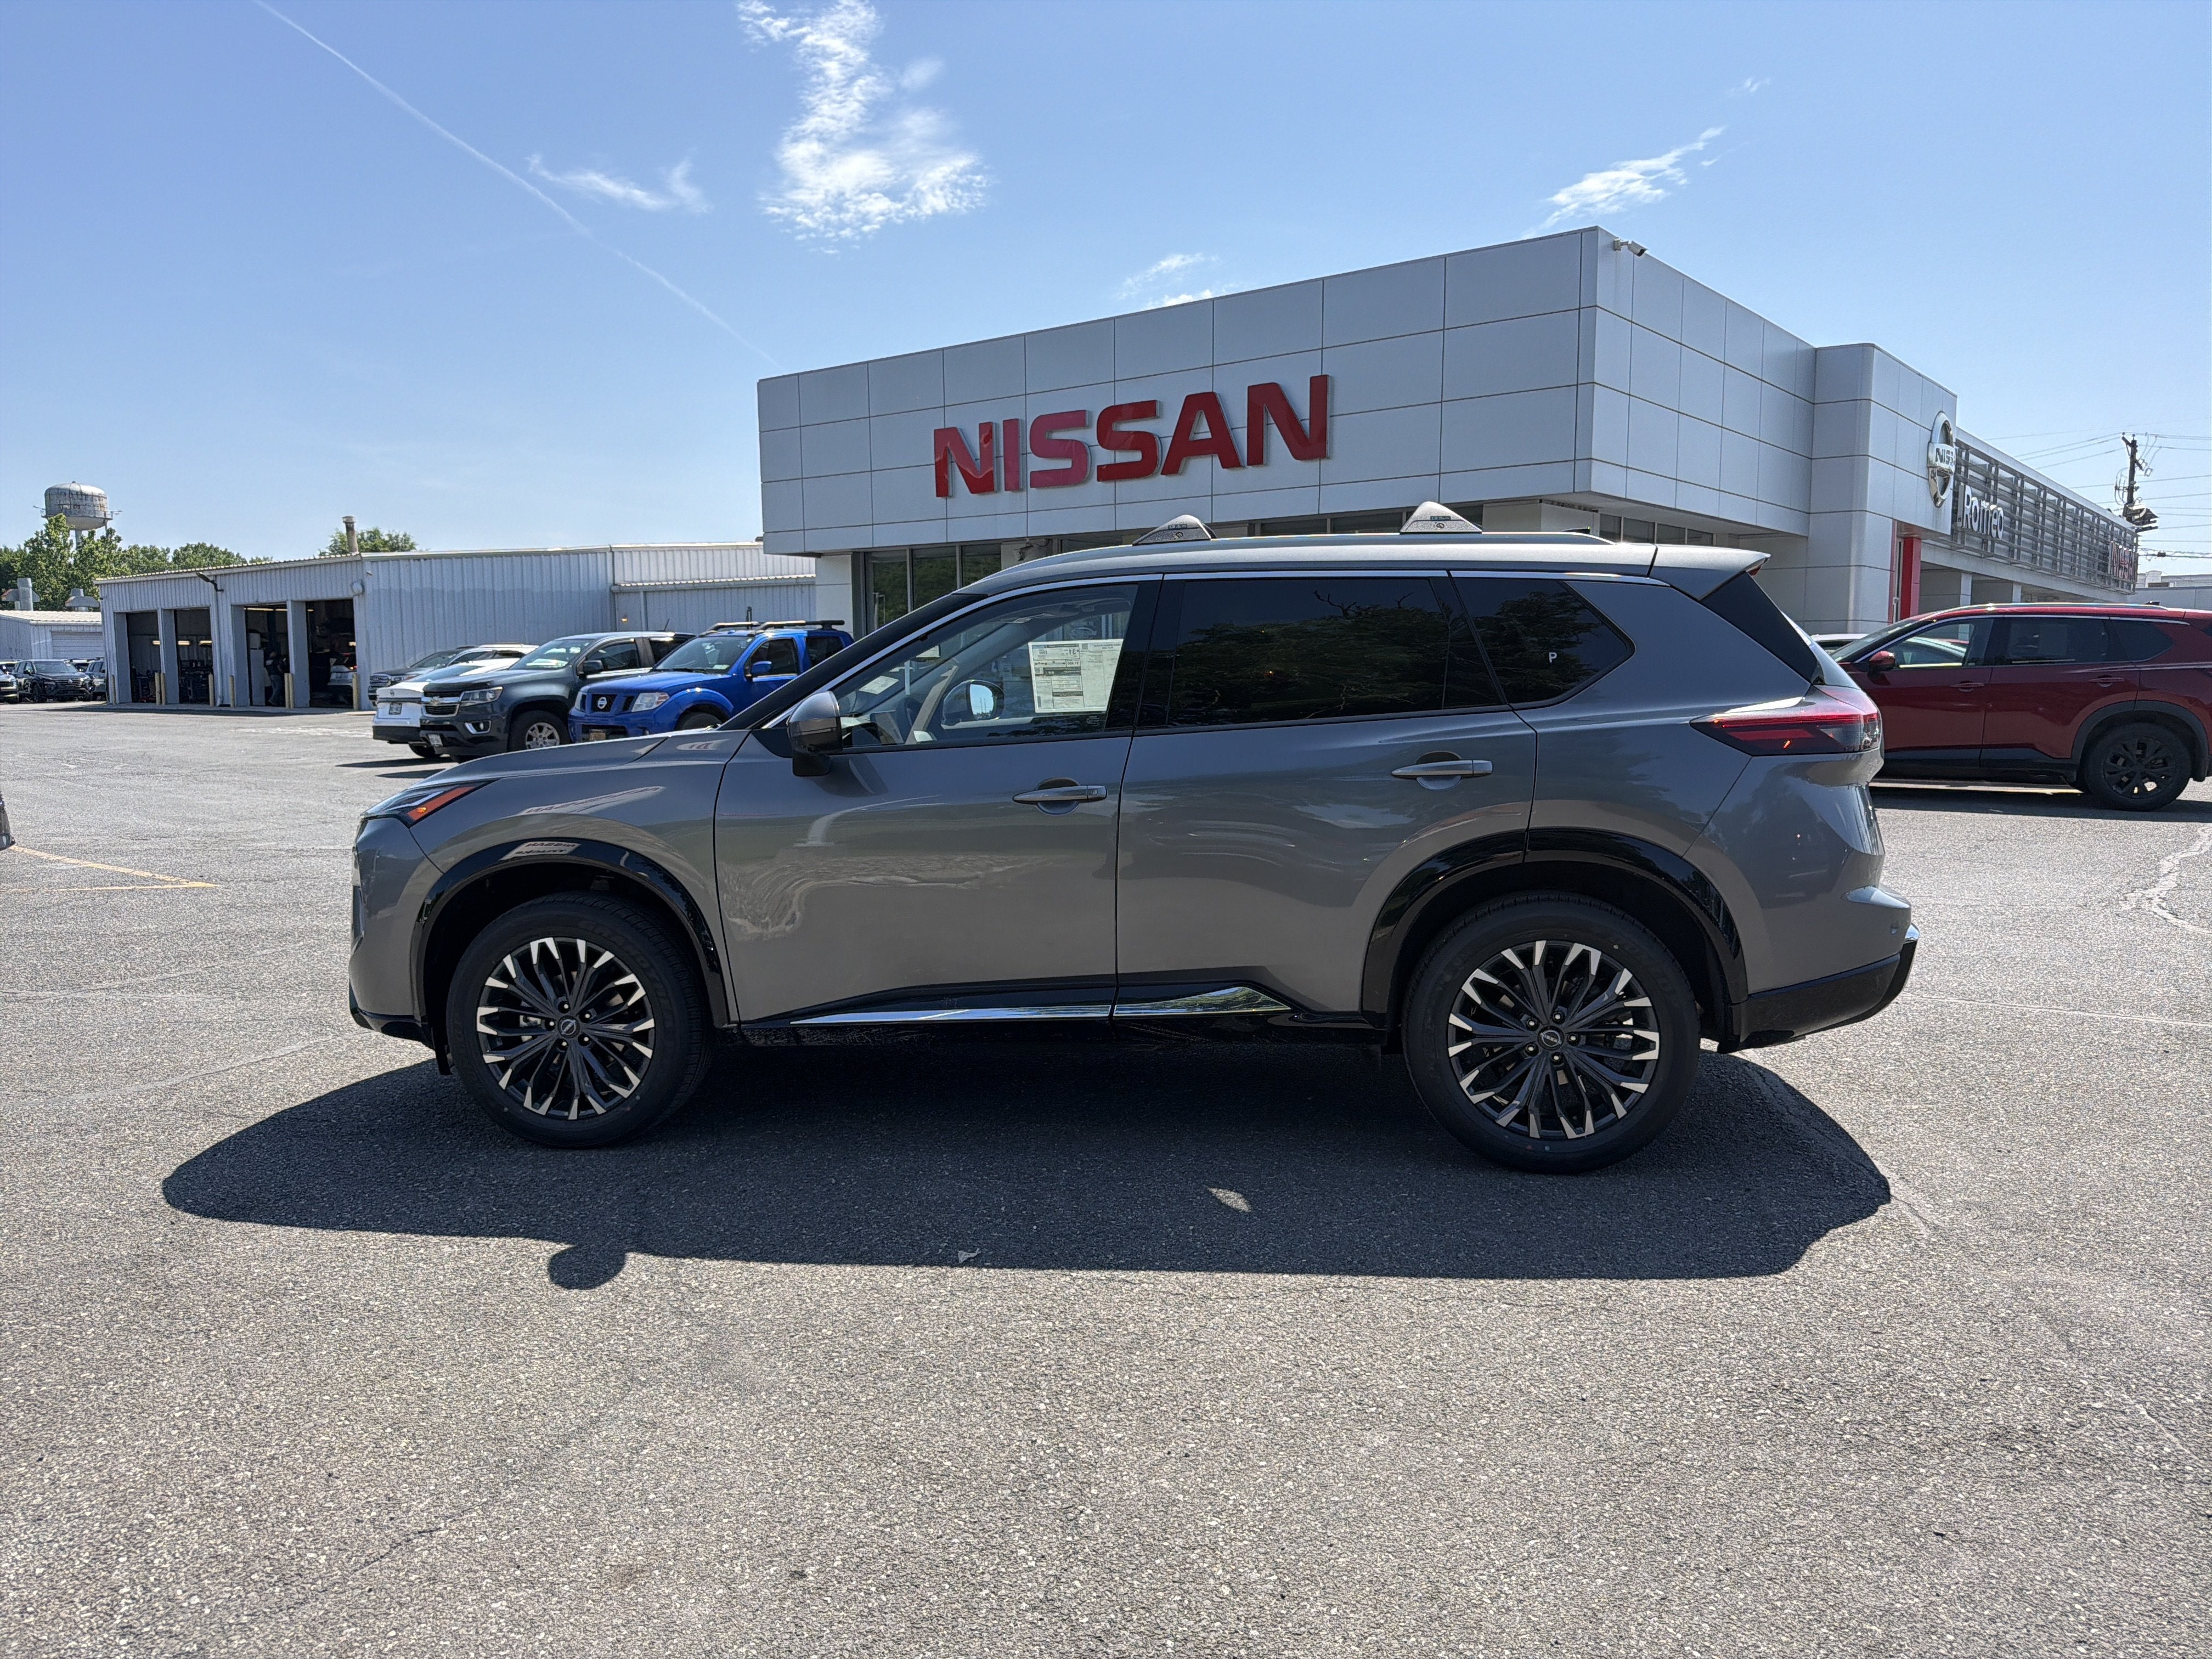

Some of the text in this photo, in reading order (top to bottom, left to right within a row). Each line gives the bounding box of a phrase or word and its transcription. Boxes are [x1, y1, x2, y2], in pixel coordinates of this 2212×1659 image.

[934, 374, 1331, 498] NISSAN
[1957, 482, 2004, 540] Romeo
[1549, 652, 1557, 663] P
